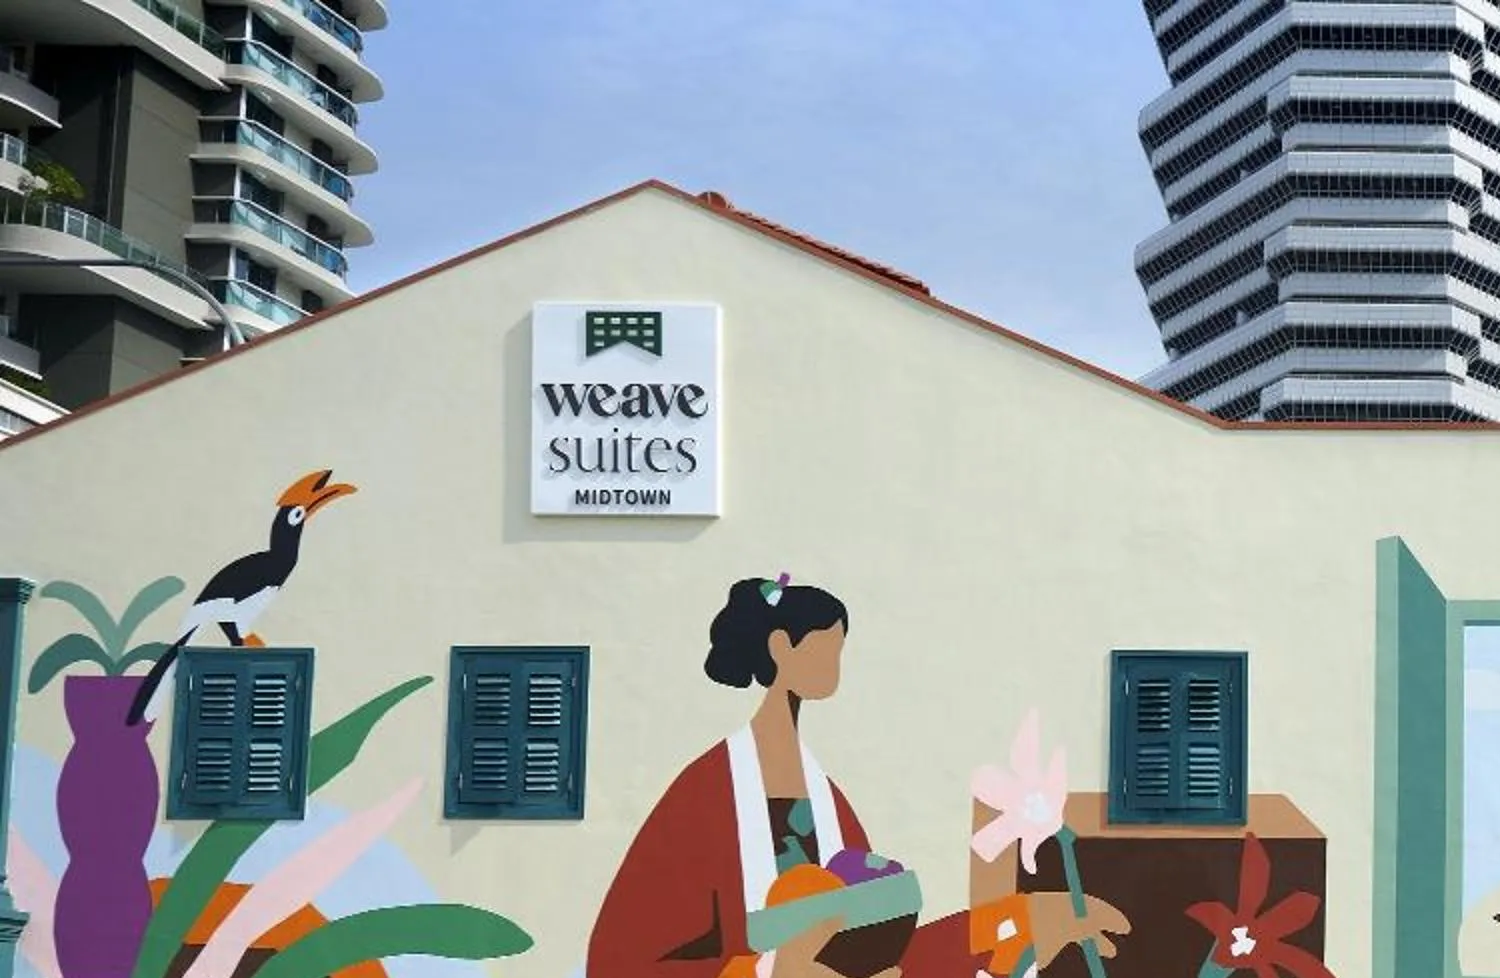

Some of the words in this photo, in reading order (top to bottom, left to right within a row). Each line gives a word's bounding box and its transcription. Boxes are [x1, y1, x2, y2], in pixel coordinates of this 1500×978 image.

[540, 383, 709, 418] weave
[549, 427, 698, 473] suites
[575, 489, 671, 505] MIDTOWN
